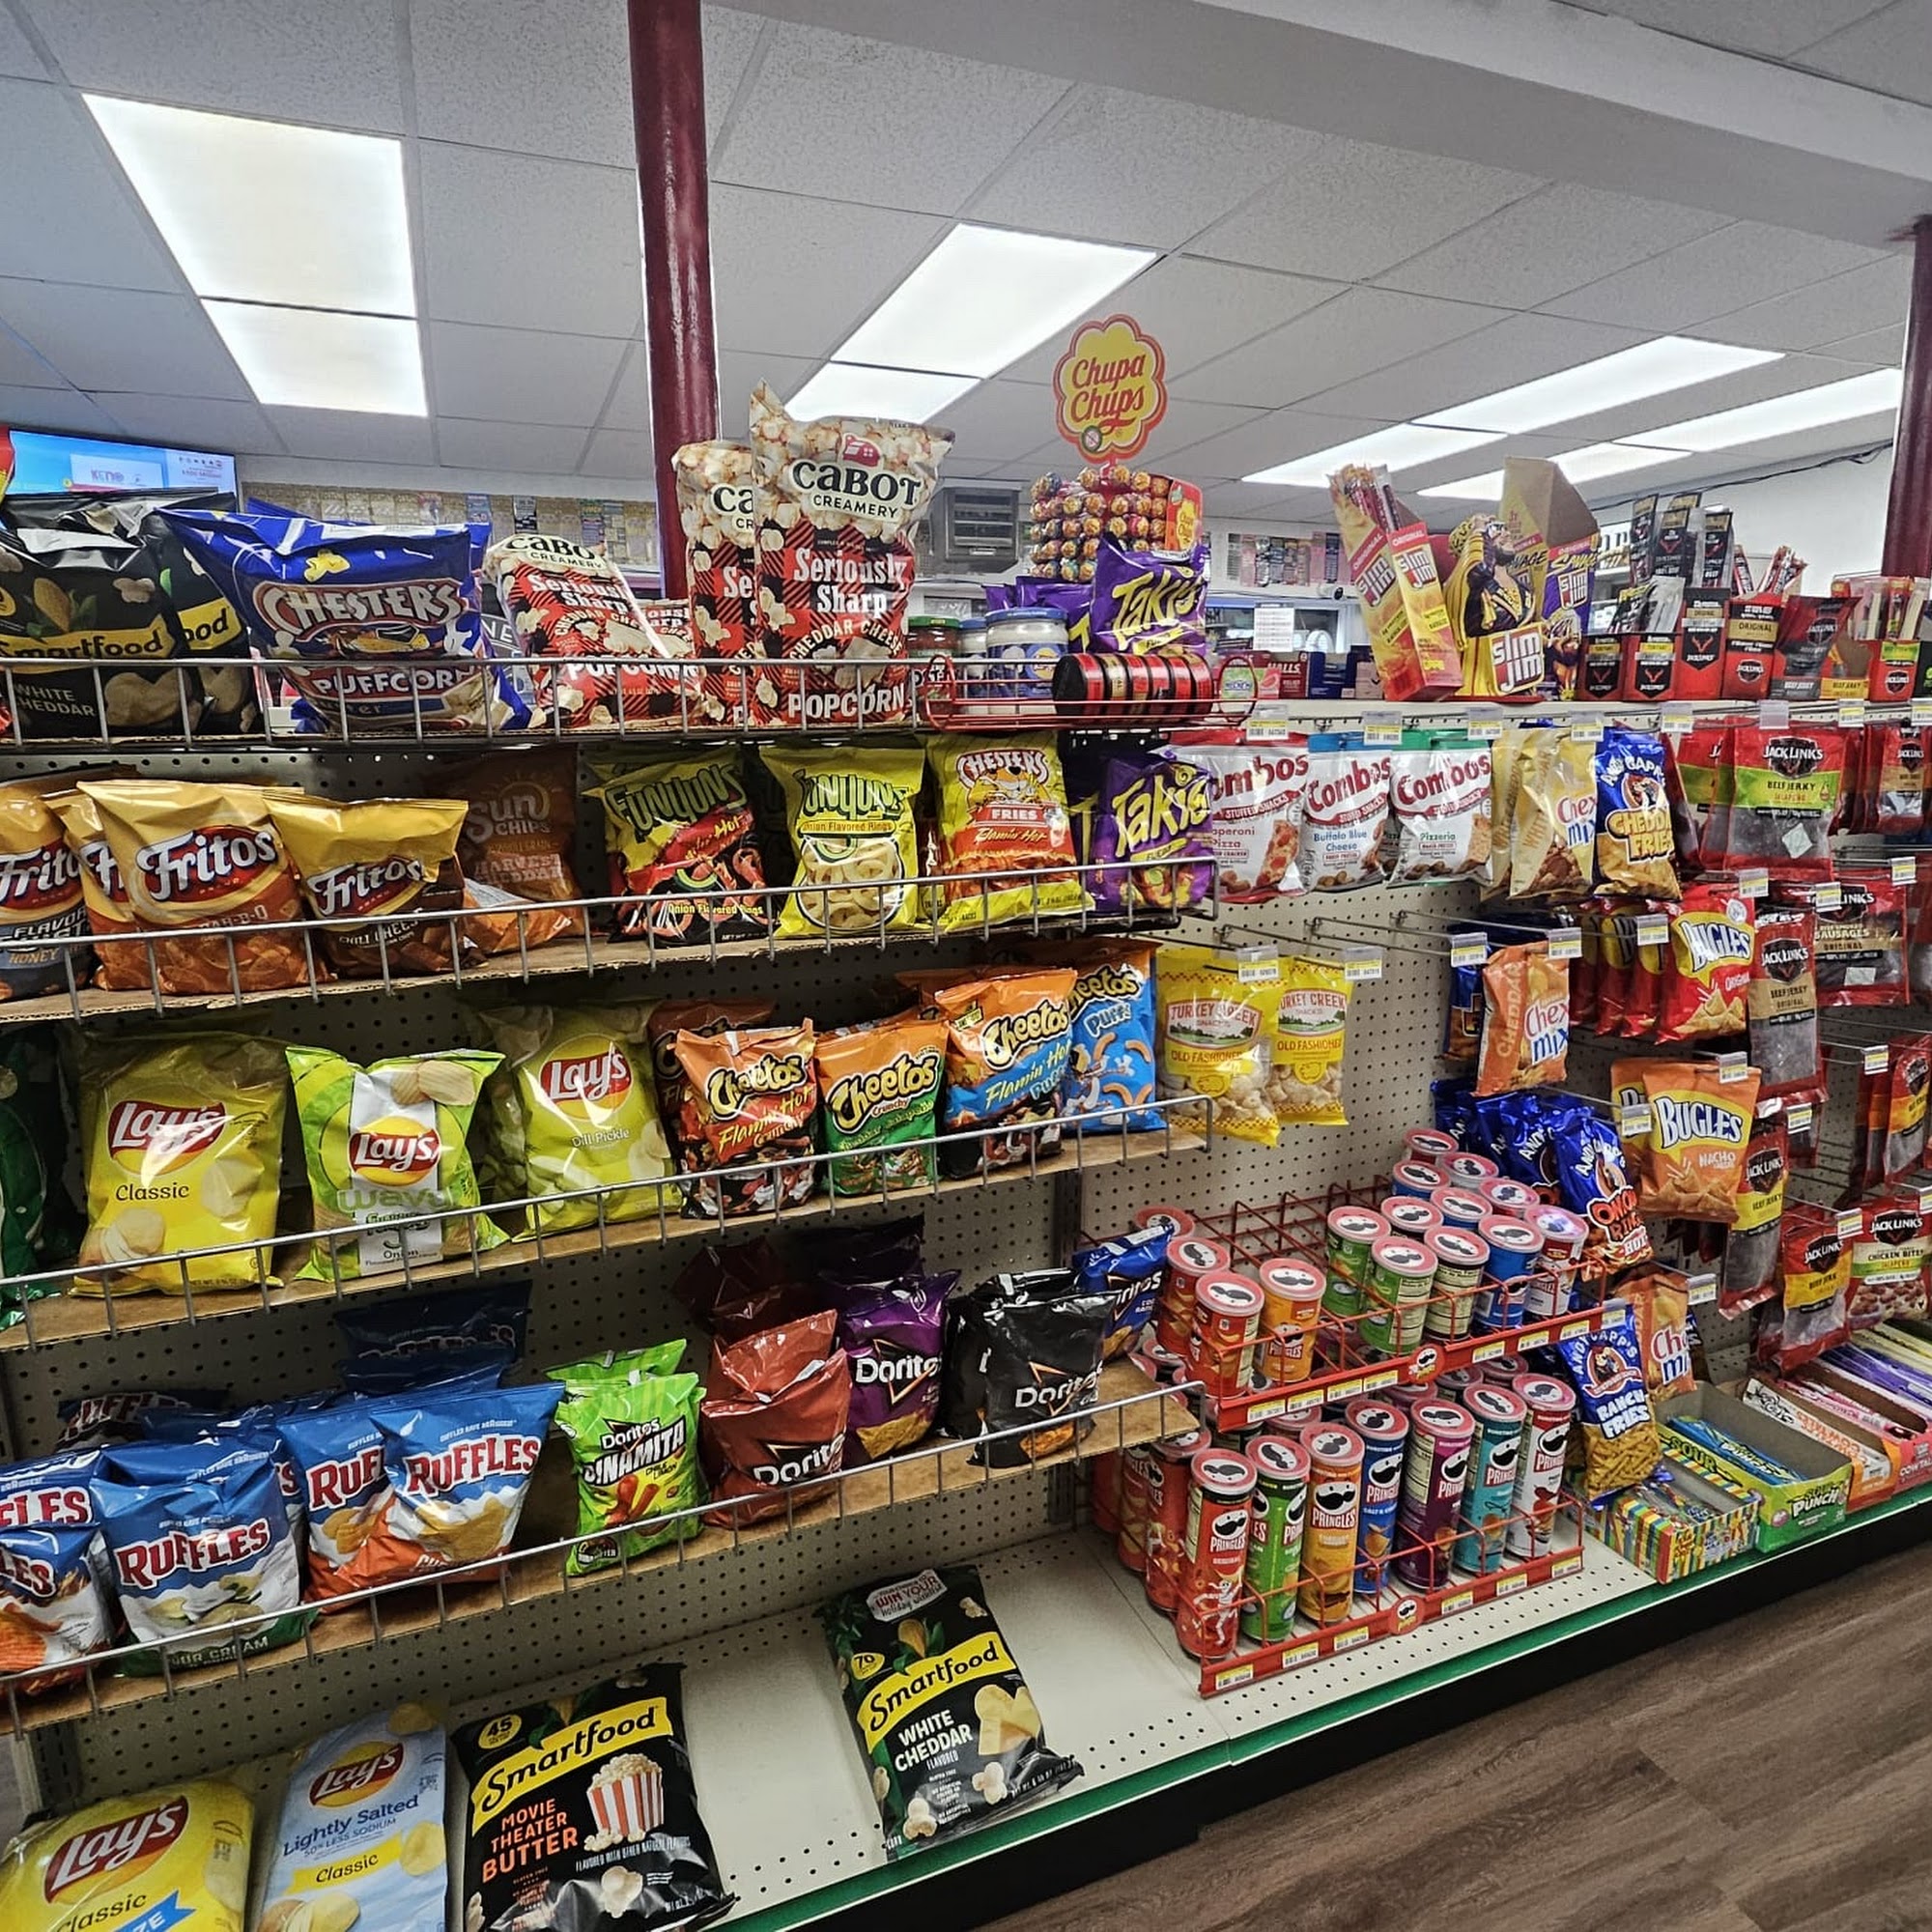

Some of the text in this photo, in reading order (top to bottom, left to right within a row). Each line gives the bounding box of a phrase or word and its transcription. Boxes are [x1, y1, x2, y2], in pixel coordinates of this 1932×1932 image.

[1072, 352, 1145, 395] Chupa
[1071, 384, 1145, 426] Chups
[813, 494, 898, 520] CREAMERY
[529, 552, 603, 570] CREAMERY
[794, 547, 909, 591] Seriously
[262, 584, 461, 636] CHESTER'S
[563, 590, 628, 614] Sharp
[817, 583, 888, 619] Sharp
[554, 611, 606, 637] CHEDDAR
[789, 620, 904, 661] CHEDDAR CHEESE
[1738, 621, 1773, 633] ORIGINAL
[14, 682, 75, 703] WHITE
[312, 664, 476, 696] PUFFCORN
[787, 686, 904, 720] POPCORN
[957, 749, 1048, 784] CHESTER'S
[1213, 753, 1309, 802] ombos
[1397, 753, 1492, 805] Combos
[605, 763, 748, 838] FUNYUNS
[792, 768, 910, 820] FUNYUNS
[1308, 755, 1391, 813] Combos
[1767, 780, 1816, 793] BEEF JERKY
[468, 791, 538, 842] Sun
[495, 817, 551, 835] CHIPS
[829, 821, 867, 832] Flavored
[868, 820, 894, 832] Rings
[991, 808, 1038, 821] FRIES
[1556, 795, 1597, 824] Chex
[714, 817, 742, 838] Hot
[1314, 829, 1368, 843] Buffalo Blue
[1420, 831, 1457, 842] Pizzeria
[1325, 841, 1359, 853] Cheese
[1633, 831, 1674, 859] FRIES
[136, 826, 278, 903] Fritos
[306, 859, 423, 916] Fritos
[14, 907, 88, 939] FLAVOR
[669, 902, 696, 916] Onion
[1685, 920, 1751, 973] BUGLES
[1814, 928, 1870, 940] SAUSAGES
[1824, 941, 1863, 952] ORIGINAL
[9, 947, 61, 965] HONEY
[1067, 968, 1139, 1011] heetos
[1280, 992, 1346, 1010] URKEY CREEK
[1770, 983, 1809, 998] BEEF JERKY
[1170, 1001, 1215, 1021] TURKEY
[1496, 960, 1524, 1058] CHEDDAR
[1523, 999, 1570, 1037] Chex
[983, 1001, 1069, 1066] Cheetos
[1277, 1039, 1296, 1052] OLD
[1532, 1029, 1570, 1064] mix
[1171, 1049, 1190, 1062] OLD
[552, 1051, 628, 1102] Lay's
[708, 1054, 805, 1119] Cheetos
[985, 1059, 1044, 1109] Flamin'
[780, 1085, 814, 1114] Hot
[831, 1055, 939, 1133] Cheetos
[871, 1098, 909, 1118] Crunchy
[111, 1101, 223, 1152] Lay's
[571, 1126, 631, 1148] Dill Pickle
[1656, 1095, 1743, 1151] BUGLES
[353, 1131, 440, 1174] Lay's
[1698, 1151, 1737, 1168] NACHO
[116, 1181, 190, 1202] Classic
[1592, 1187, 1637, 1225] ONION
[1868, 1250, 1901, 1263] CHICKEN
[1572, 1336, 1590, 1377] ANDY
[1596, 1392, 1646, 1422] RANCH
[1603, 1405, 1651, 1439] FRIES
[600, 1417, 662, 1450] Doritos
[407, 1435, 541, 1495] RUFFLES
[1669, 1435, 1719, 1472] SOUR
[1312, 1507, 1357, 1529] PRINGLES
[1792, 1490, 1840, 1518] PUNCH
[116, 1520, 269, 1586] RUFFLES
[1210, 1533, 1246, 1553] PRINGLES
[874, 1576, 938, 1609] WIN YOUR
[854, 1654, 875, 1670] 70
[869, 1640, 1000, 1732] Smartfood
[487, 1716, 514, 1737] 45
[897, 1709, 954, 1747] WHITE
[481, 1707, 656, 1813] Smartfood
[894, 1722, 974, 1773] CHEDDAR
[925, 1749, 959, 1772] FLAVORED
[319, 1747, 398, 1797] Lay's
[282, 1795, 419, 1858] Lightly Salted
[500, 1798, 556, 1832] MOVIE
[51, 1801, 185, 1890] Lay's
[324, 1833, 351, 1850] LESS
[351, 1817, 397, 1841] SODIUM
[490, 1811, 568, 1854] THEATER
[316, 1854, 379, 1883] Classic
[481, 1826, 579, 1885] BUTTER
[575, 1856, 606, 1873] FLAVORED
[621, 1846, 641, 1860] OTHER
